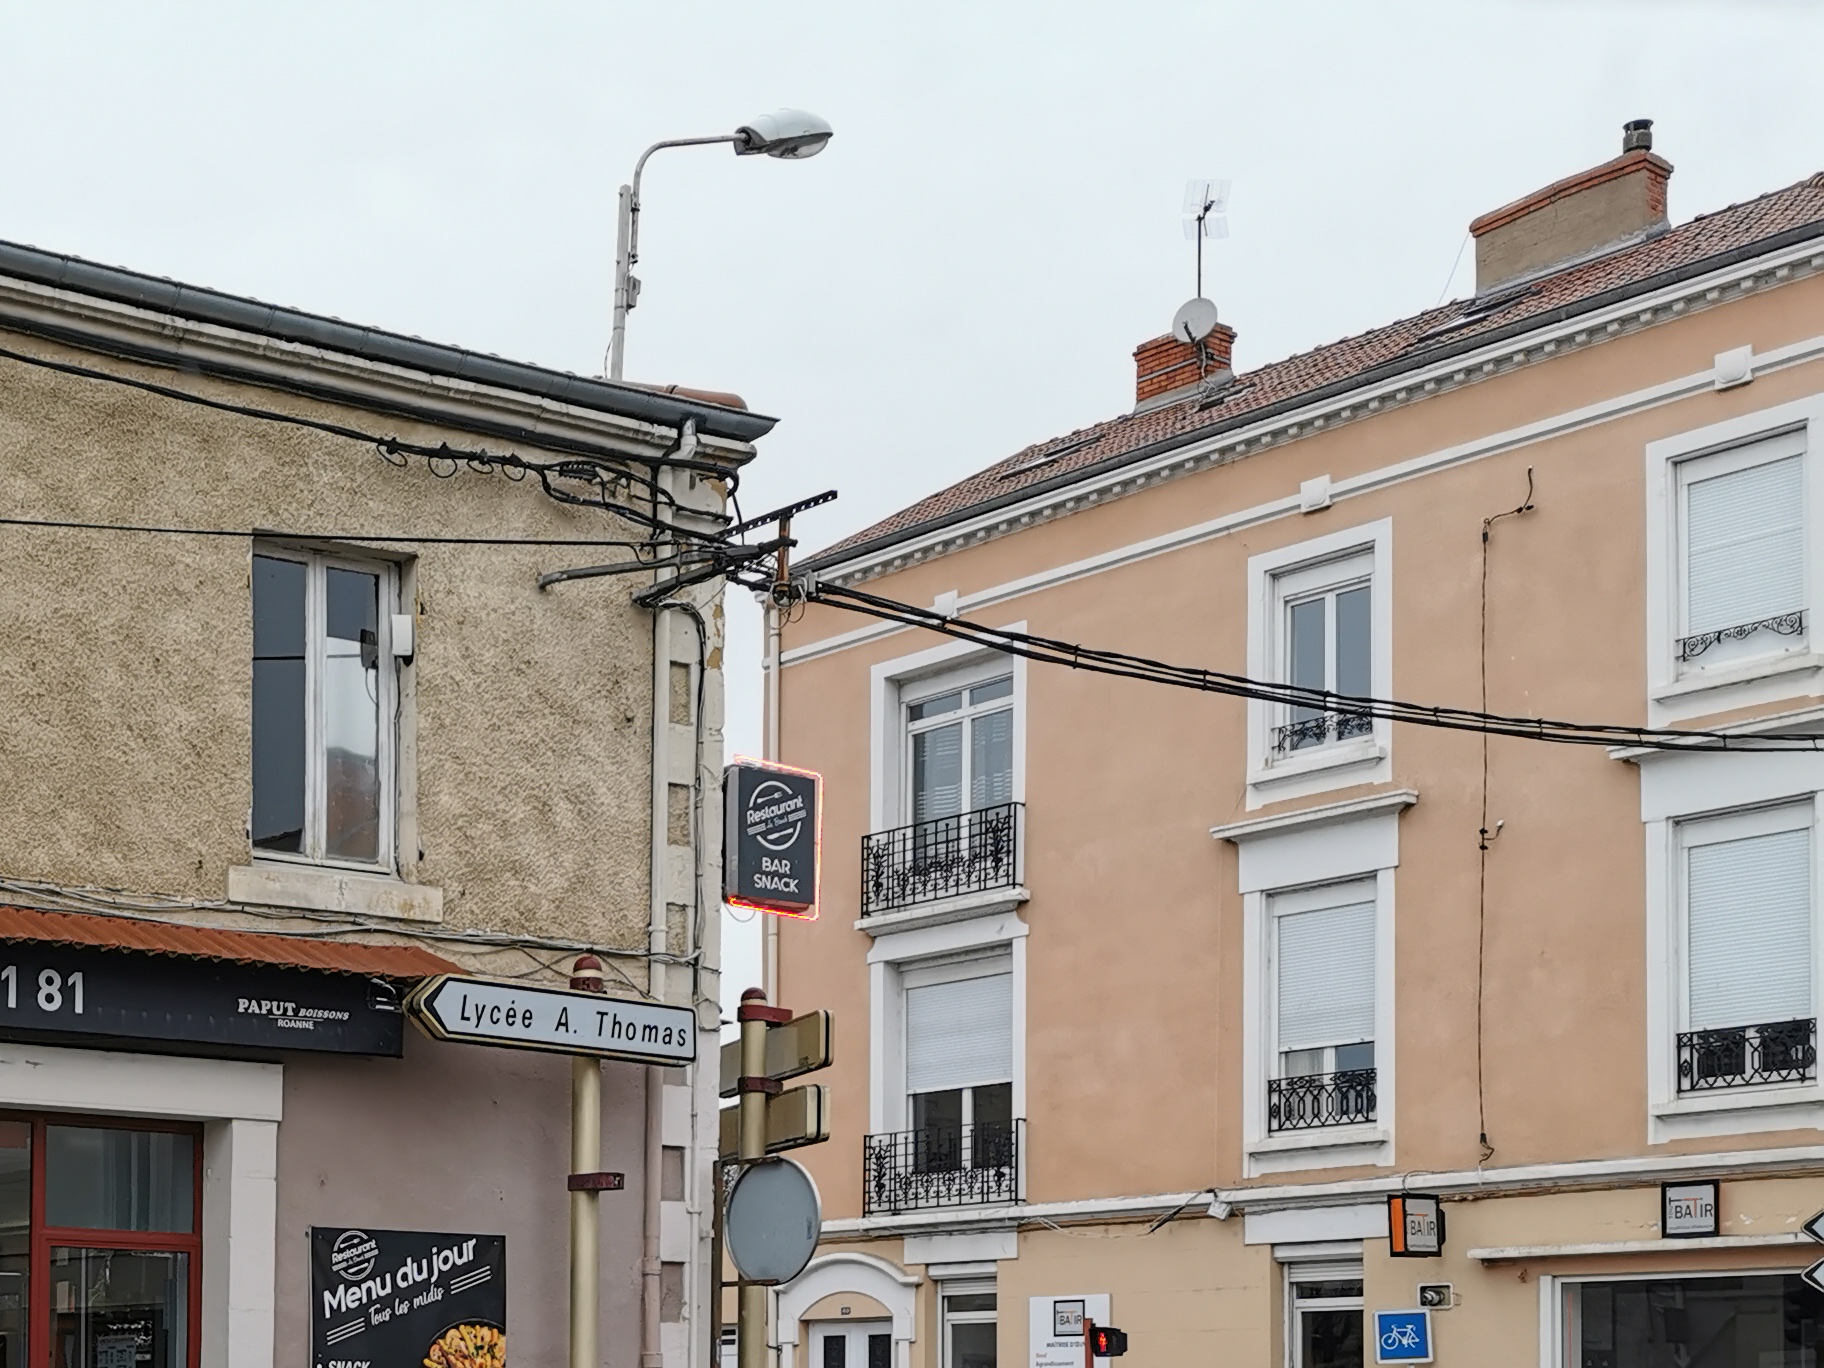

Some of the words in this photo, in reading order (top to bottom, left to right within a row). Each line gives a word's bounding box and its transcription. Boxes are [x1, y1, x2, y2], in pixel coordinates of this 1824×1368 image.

[747, 795, 803, 824] Restaurant
[762, 857, 790, 875] BAR
[754, 875, 799, 893] SNACK
[36, 969, 85, 1014] 81
[237, 998, 296, 1016] PAPUT
[460, 993, 534, 1029] Lycée
[555, 1006, 577, 1035] A.
[596, 1010, 687, 1047] Thomas
[277, 1019, 314, 1030] ROANNE
[332, 1239, 377, 1264] Restaurant
[323, 1271, 391, 1319] Menu
[396, 1256, 428, 1288] du
[429, 1237, 477, 1280] jour
[368, 1304, 391, 1326] Tous
[394, 1295, 409, 1316] les
[414, 1284, 445, 1309] midis
